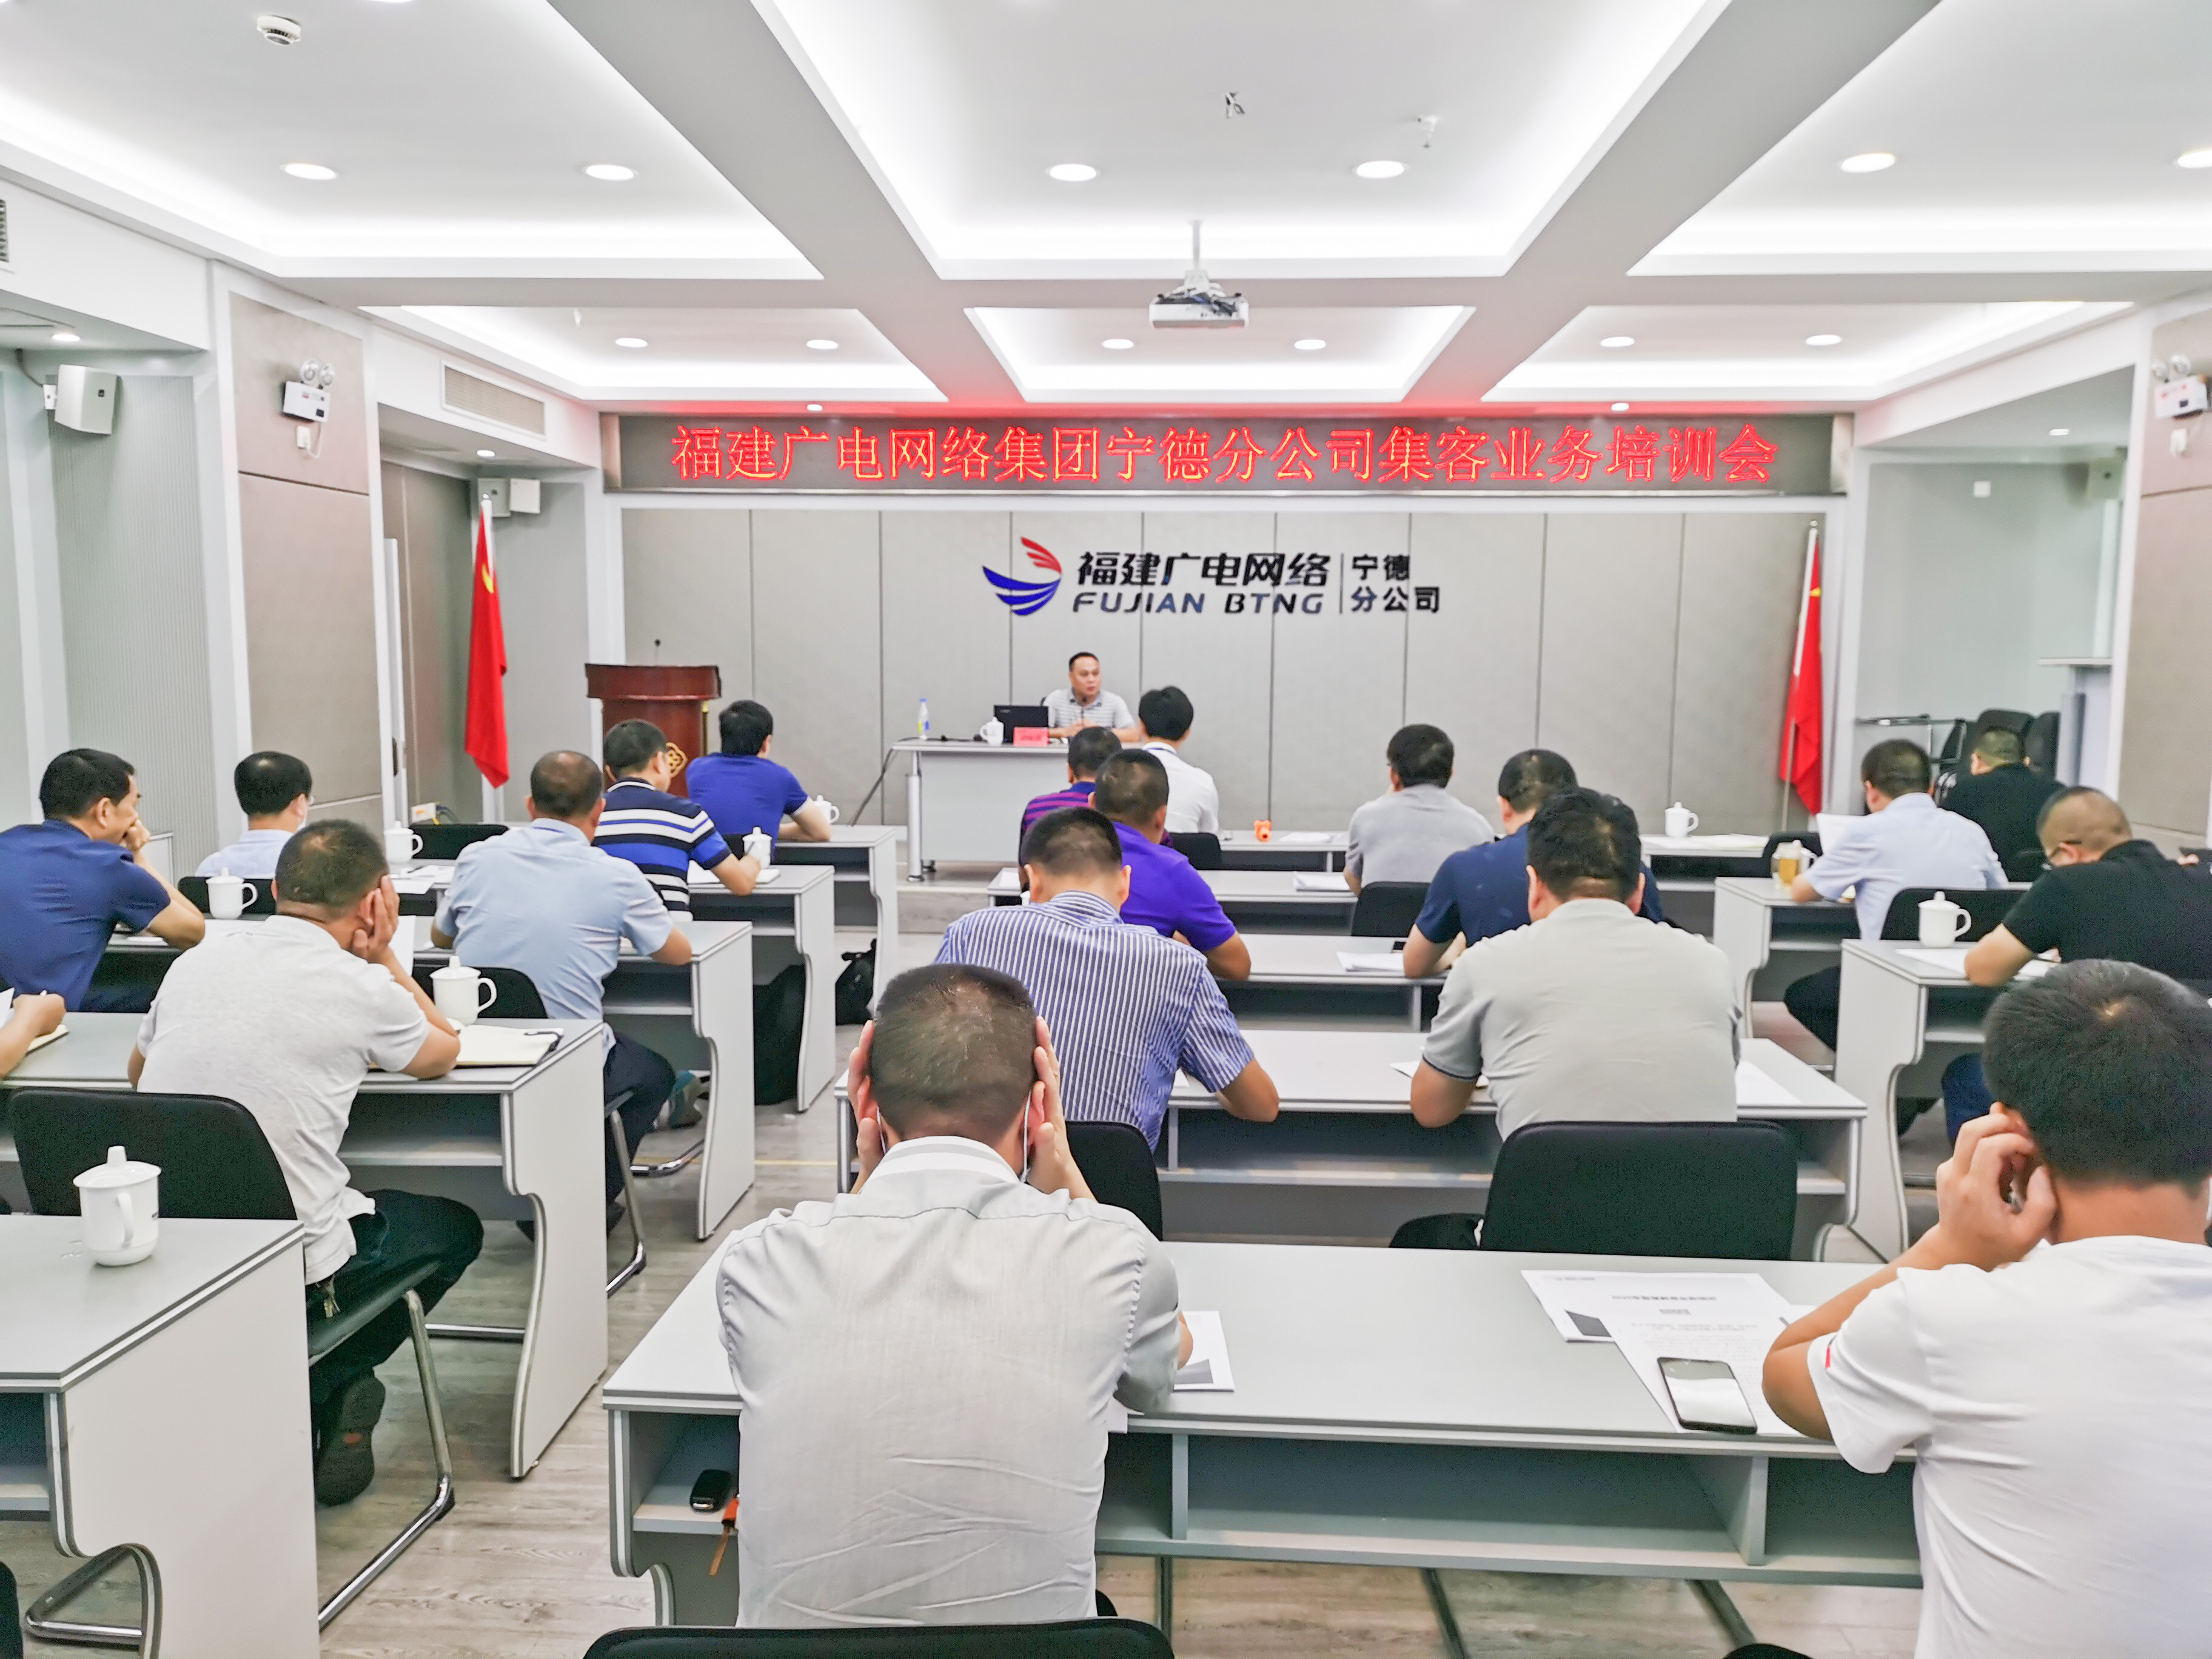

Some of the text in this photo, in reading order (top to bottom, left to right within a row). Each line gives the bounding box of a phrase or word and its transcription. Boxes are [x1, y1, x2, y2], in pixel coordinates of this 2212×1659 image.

[671, 425, 1777, 482] 福建广电网络集团宁德分公司集客业务培训会
[1078, 552, 1330, 586] 福建广电网络
[1351, 554, 1410, 581] 宁德
[1072, 592, 1324, 614] FUJIAN BTNG
[1351, 586, 1440, 613] 分公司
